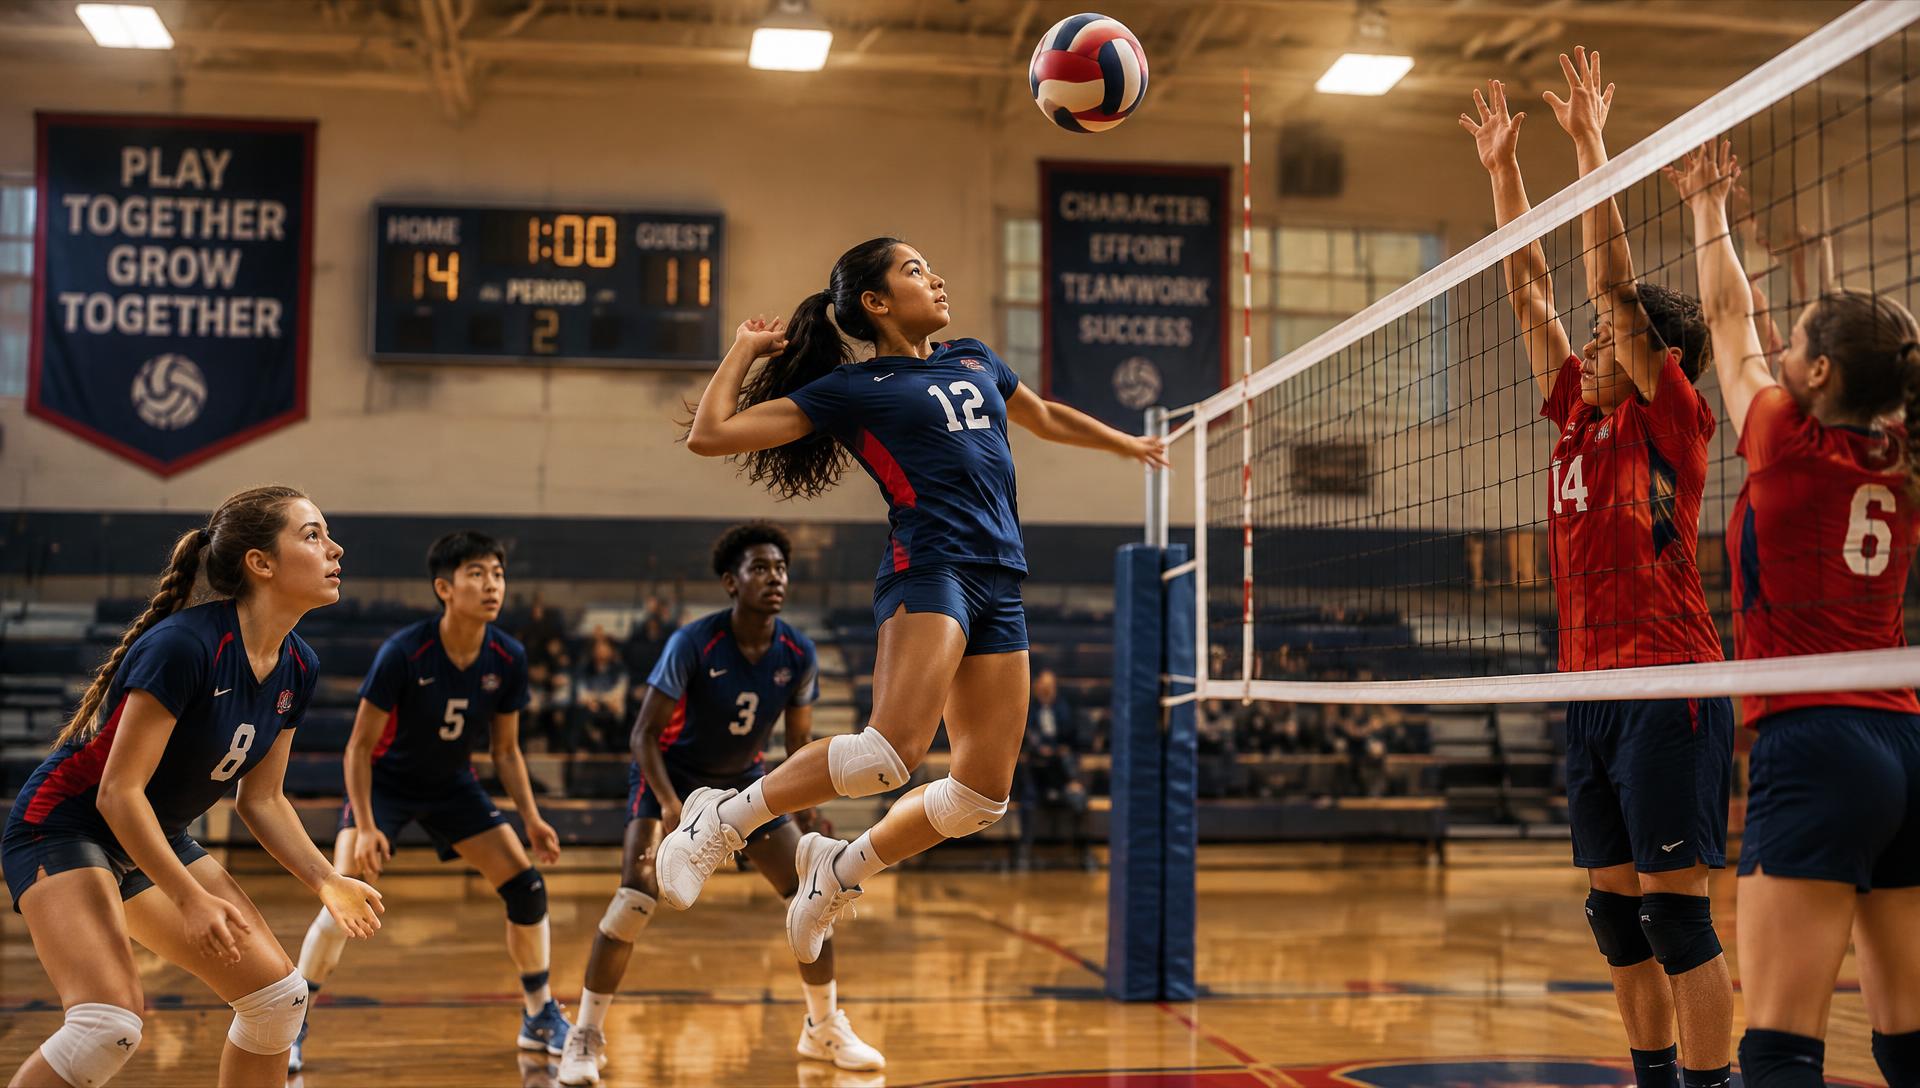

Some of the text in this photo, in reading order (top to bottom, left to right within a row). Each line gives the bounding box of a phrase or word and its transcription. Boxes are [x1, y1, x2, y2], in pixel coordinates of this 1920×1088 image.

[121, 146, 232, 189] PLAY
[63, 194, 286, 240] TOGETHER
[1059, 191, 1210, 224] CHARACTER
[387, 215, 461, 245] HOME
[529, 215, 616, 268] 1:00
[636, 222, 713, 250] GUEST
[1089, 233, 1184, 265] EFFORT
[108, 245, 241, 289] GROW
[413, 252, 459, 301] 14
[667, 258, 710, 306] 11
[1062, 272, 1210, 305] TEAMWORK
[60, 293, 282, 337] TOGETHER
[533, 309, 559, 354] 2
[1079, 314, 1192, 346] SUCCESS
[928, 380, 991, 432] 12
[1552, 455, 1588, 514] 14
[1843, 483, 1896, 576] 6
[439, 698, 469, 740] 5
[728, 691, 759, 735] 3
[211, 723, 256, 782] 8
